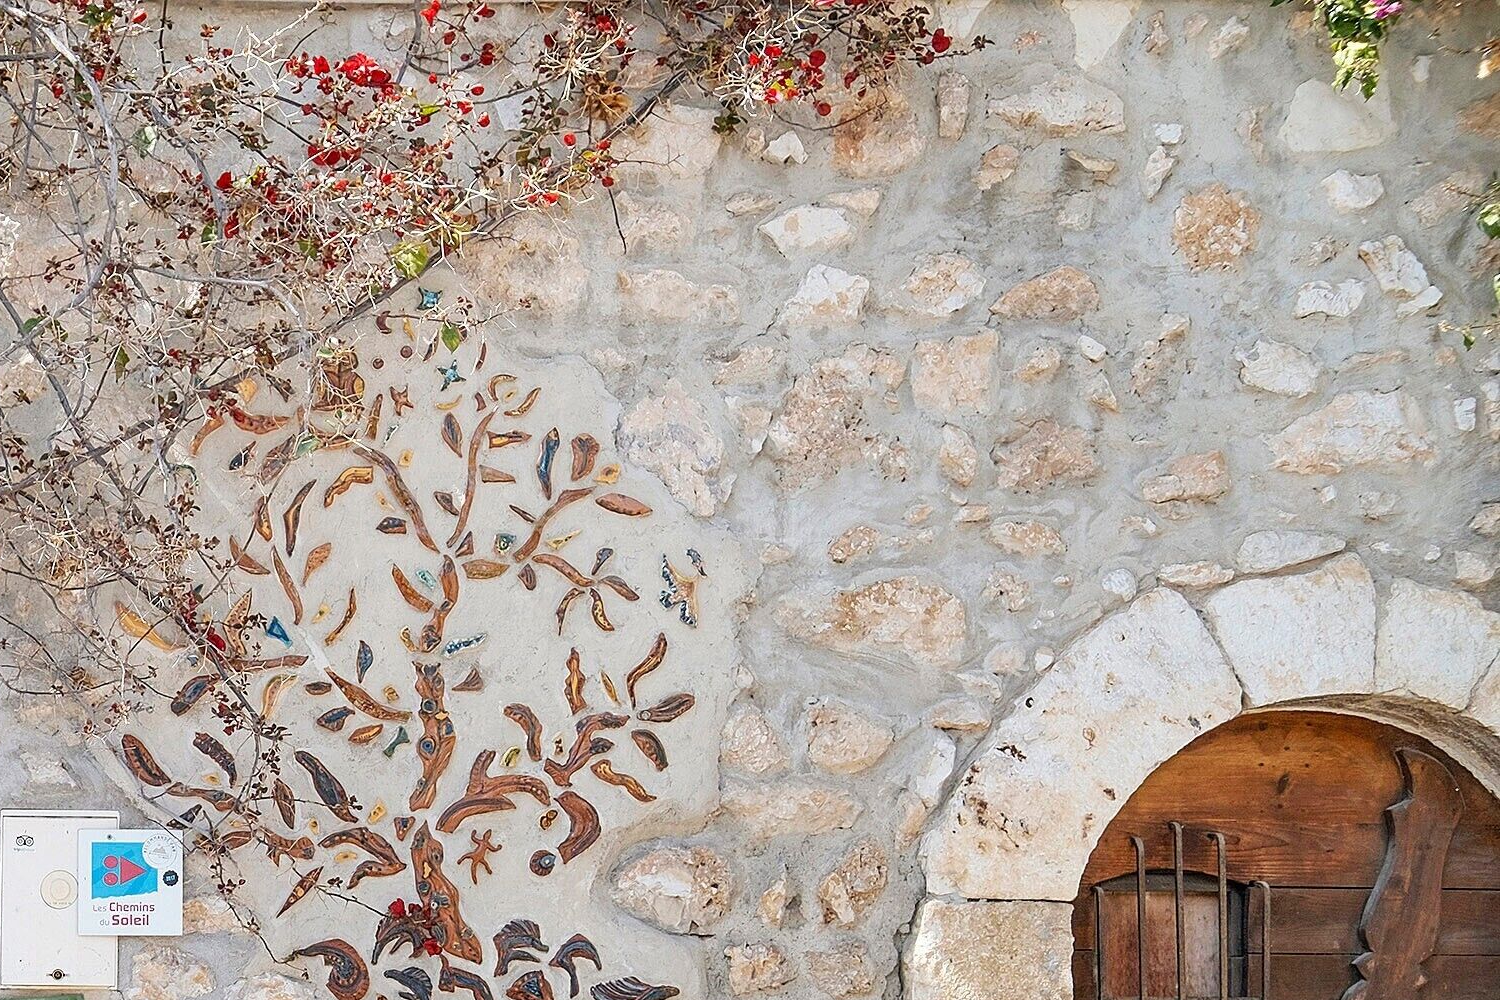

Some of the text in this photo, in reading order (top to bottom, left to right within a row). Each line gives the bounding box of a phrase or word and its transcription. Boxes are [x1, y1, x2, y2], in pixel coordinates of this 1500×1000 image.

[92, 901, 155, 912] Les Chemins
[112, 914, 149, 926] Soleil
